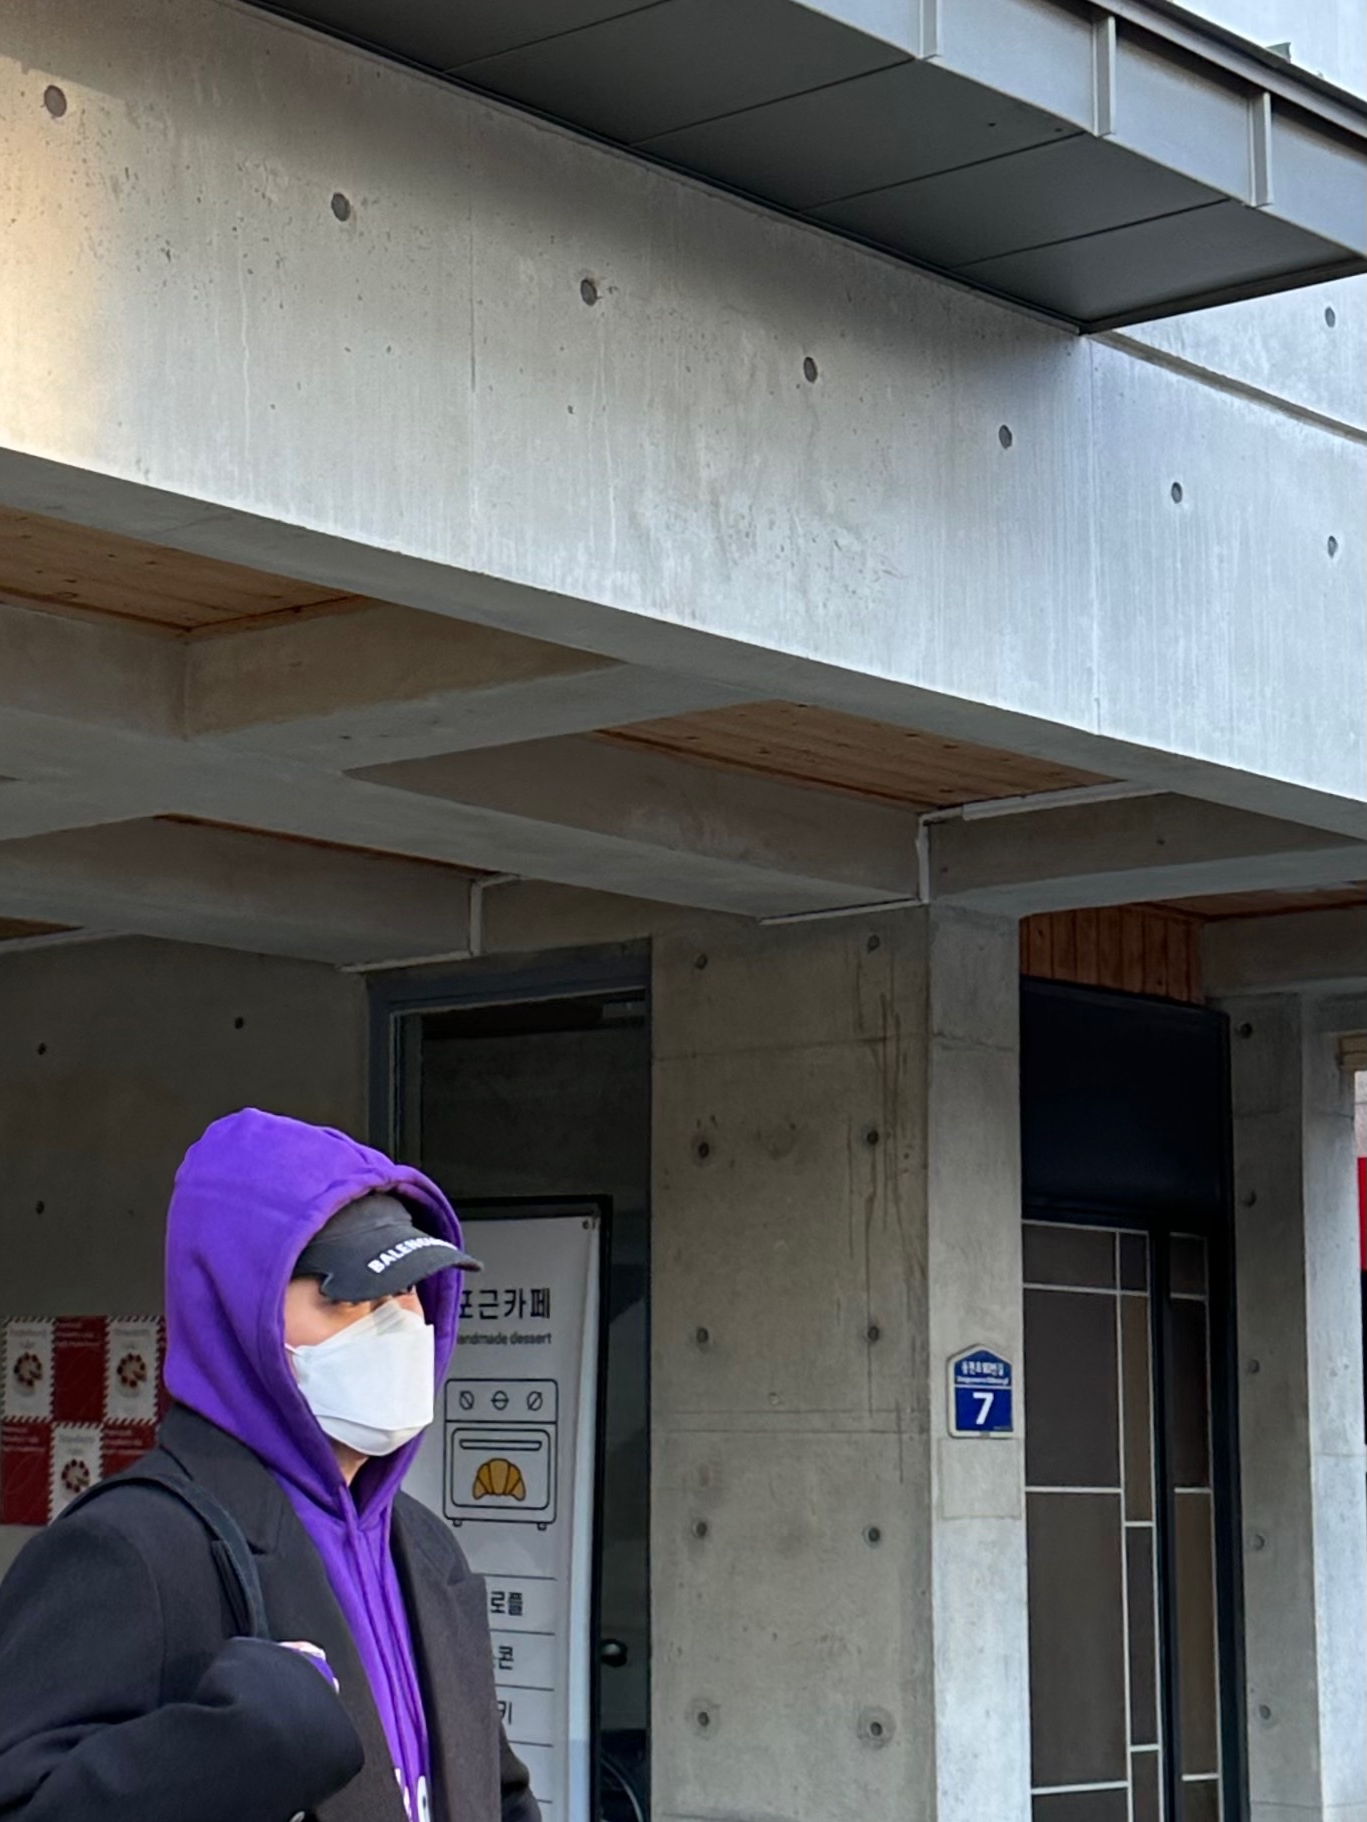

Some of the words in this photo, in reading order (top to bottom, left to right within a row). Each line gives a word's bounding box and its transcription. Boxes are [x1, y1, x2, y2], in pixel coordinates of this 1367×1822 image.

[367, 1236, 458, 1274] BALENC
[456, 1331, 508, 1346] andmade
[509, 1332, 552, 1346] dessert
[972, 1391, 995, 1425] 7
[489, 1590, 523, 1617] 로플
[492, 1645, 514, 1671] 콘
